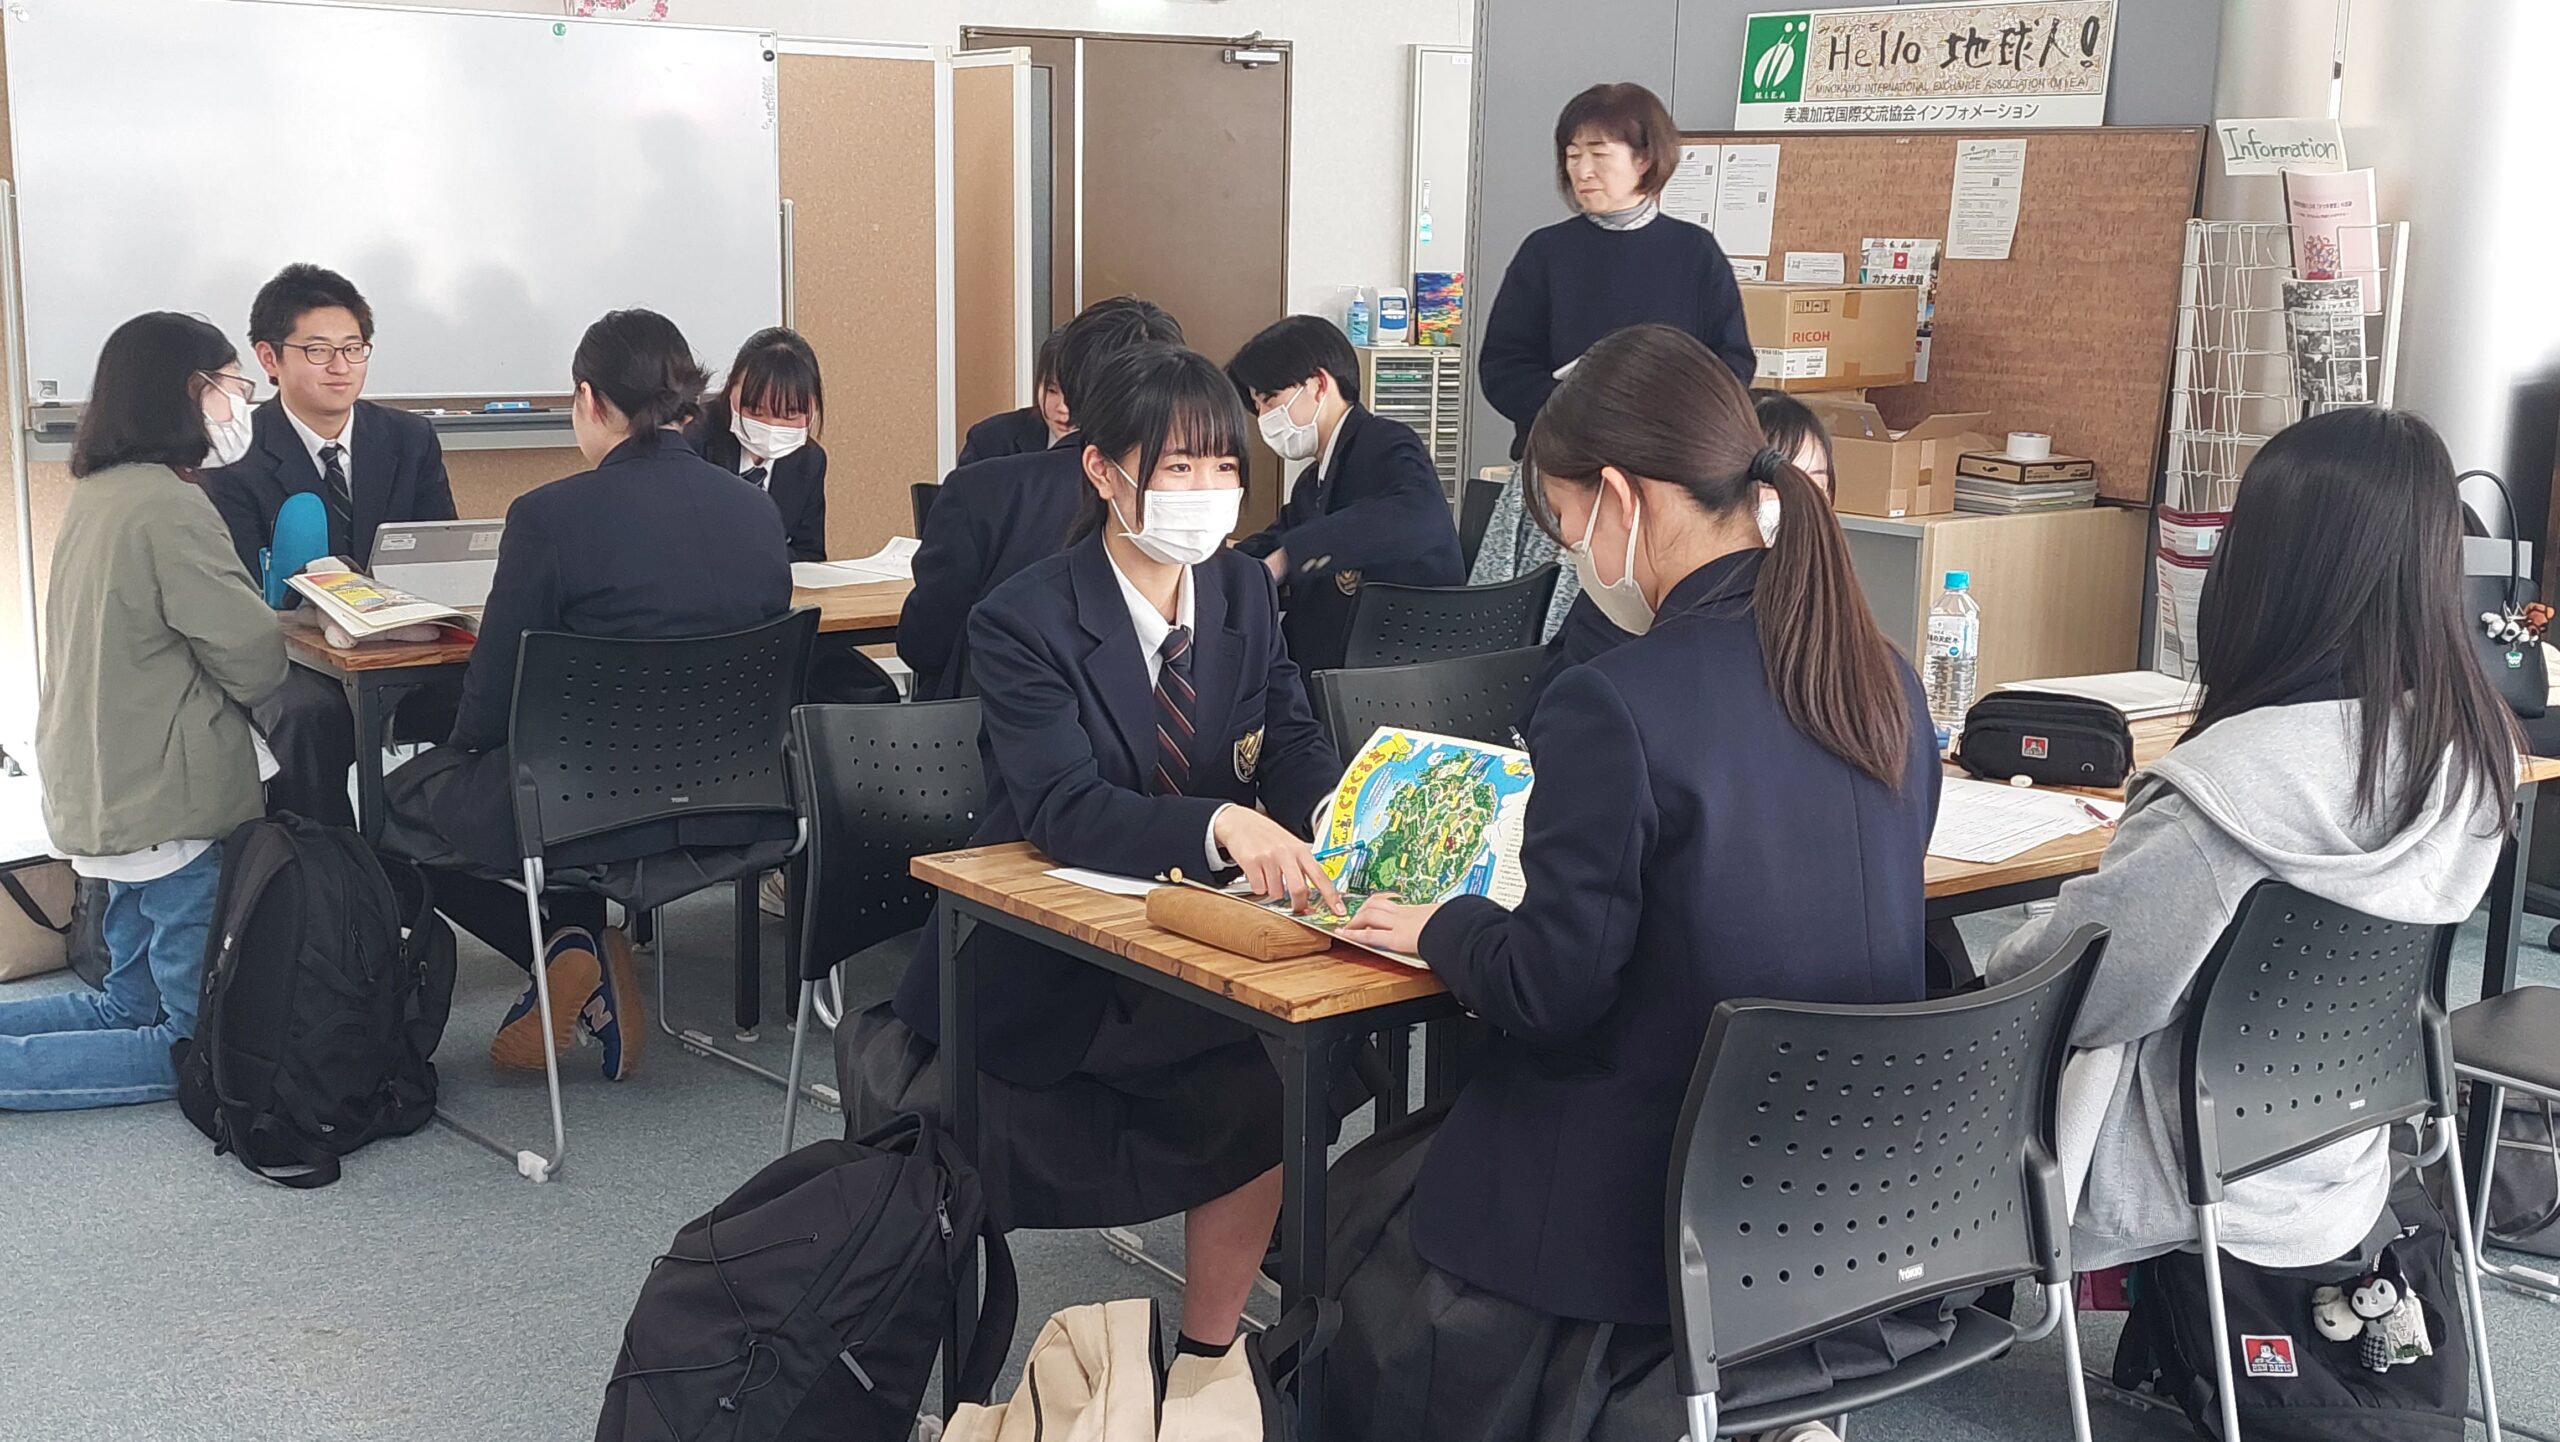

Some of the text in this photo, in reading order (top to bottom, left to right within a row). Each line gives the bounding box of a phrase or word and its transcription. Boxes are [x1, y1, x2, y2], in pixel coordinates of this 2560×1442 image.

[1828, 30, 1922, 71] Hello
[1816, 83, 1861, 94] MINOKAMO
[1865, 81, 1928, 94] INTERNATIONAL
[1933, 80, 1981, 91] EXCHANGE
[1985, 78, 2045, 90] ASSOCIATION
[1783, 104, 2040, 123] 美濃加茂国際交流協会インフォメーション
[2222, 127, 2339, 161] Information
[1792, 331, 1831, 343] RICOH
